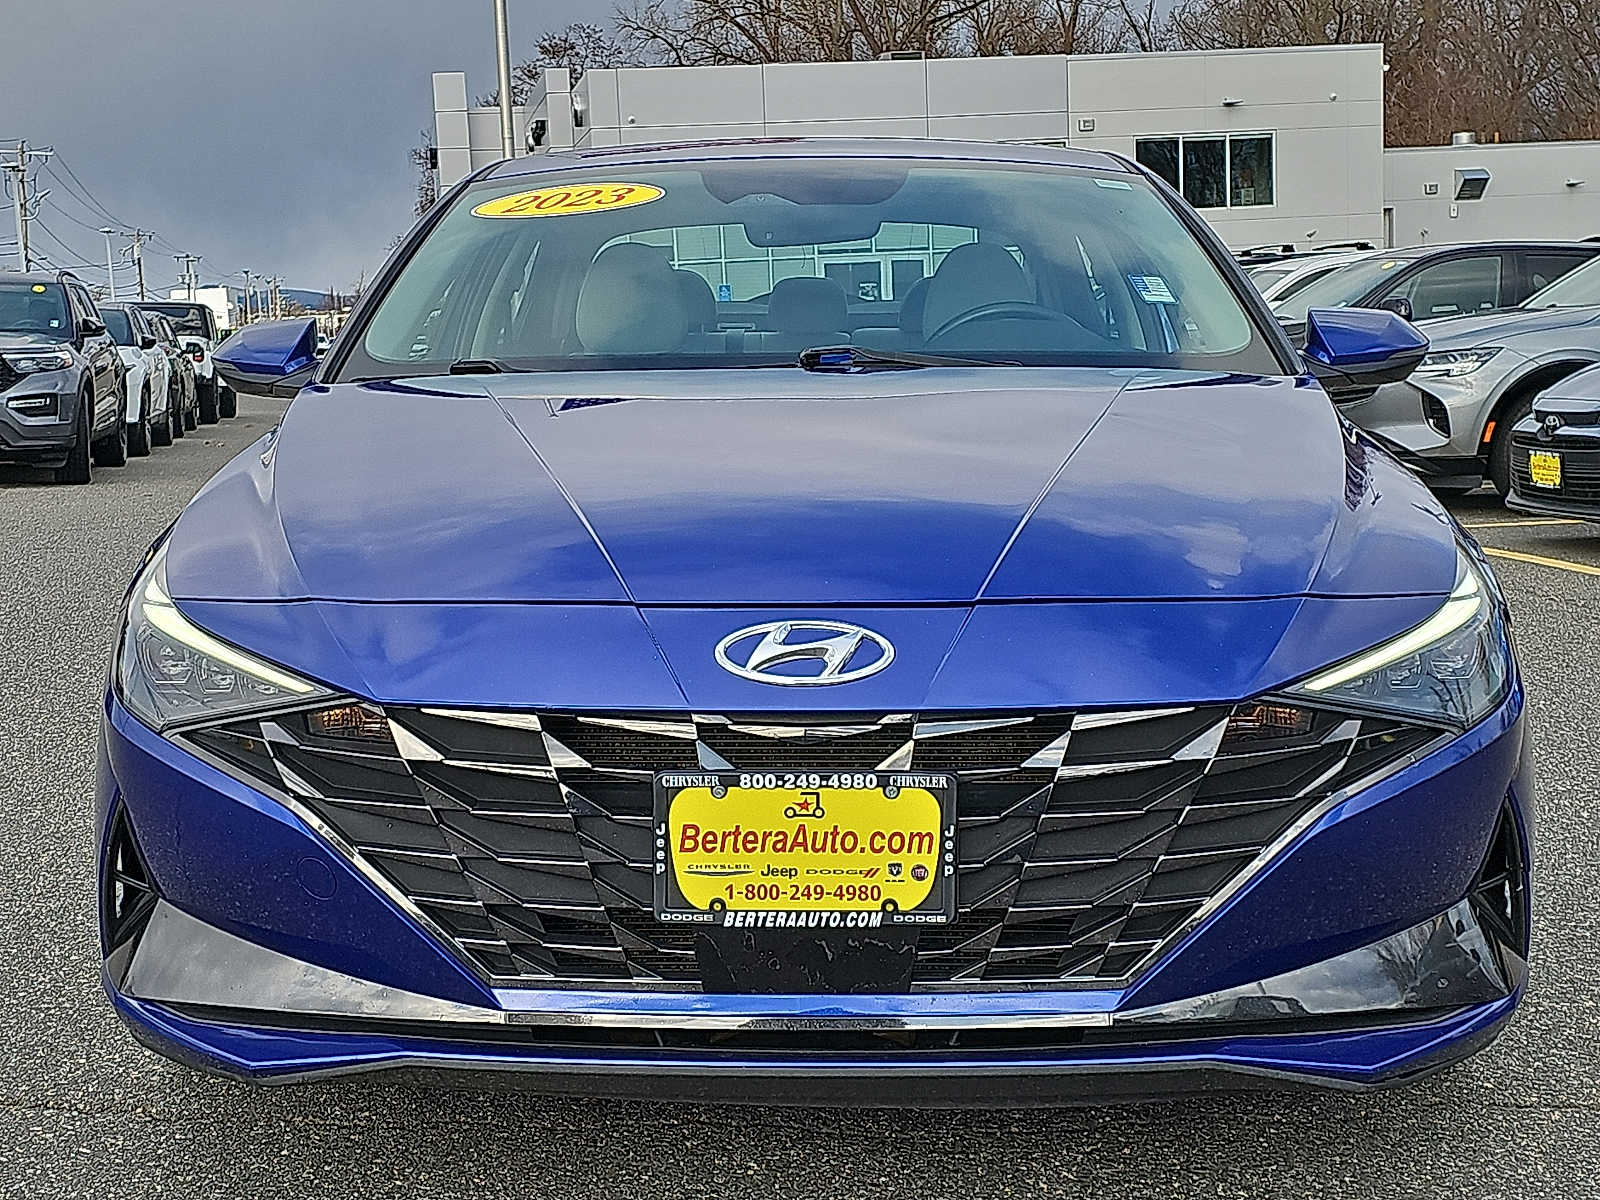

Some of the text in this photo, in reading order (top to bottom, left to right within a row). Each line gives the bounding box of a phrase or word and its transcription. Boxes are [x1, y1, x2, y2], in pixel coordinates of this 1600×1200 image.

[500, 187, 636, 214] 2023
[661, 775, 721, 788] CHRYSLER
[739, 773, 878, 790] 800-249-4980
[889, 775, 949, 789] CHRYSLER
[678, 823, 935, 855] BerteraAuto.com
[655, 822, 666, 875] Jeep
[944, 824, 955, 878] Jeep
[686, 863, 751, 871] CHRYSLER
[760, 863, 799, 880] Jeep
[723, 883, 882, 901] 1-800-249-4980
[660, 913, 714, 922] DODGE
[722, 910, 884, 928] BERTERAAUTO.COM
[893, 914, 947, 923] DODGE
